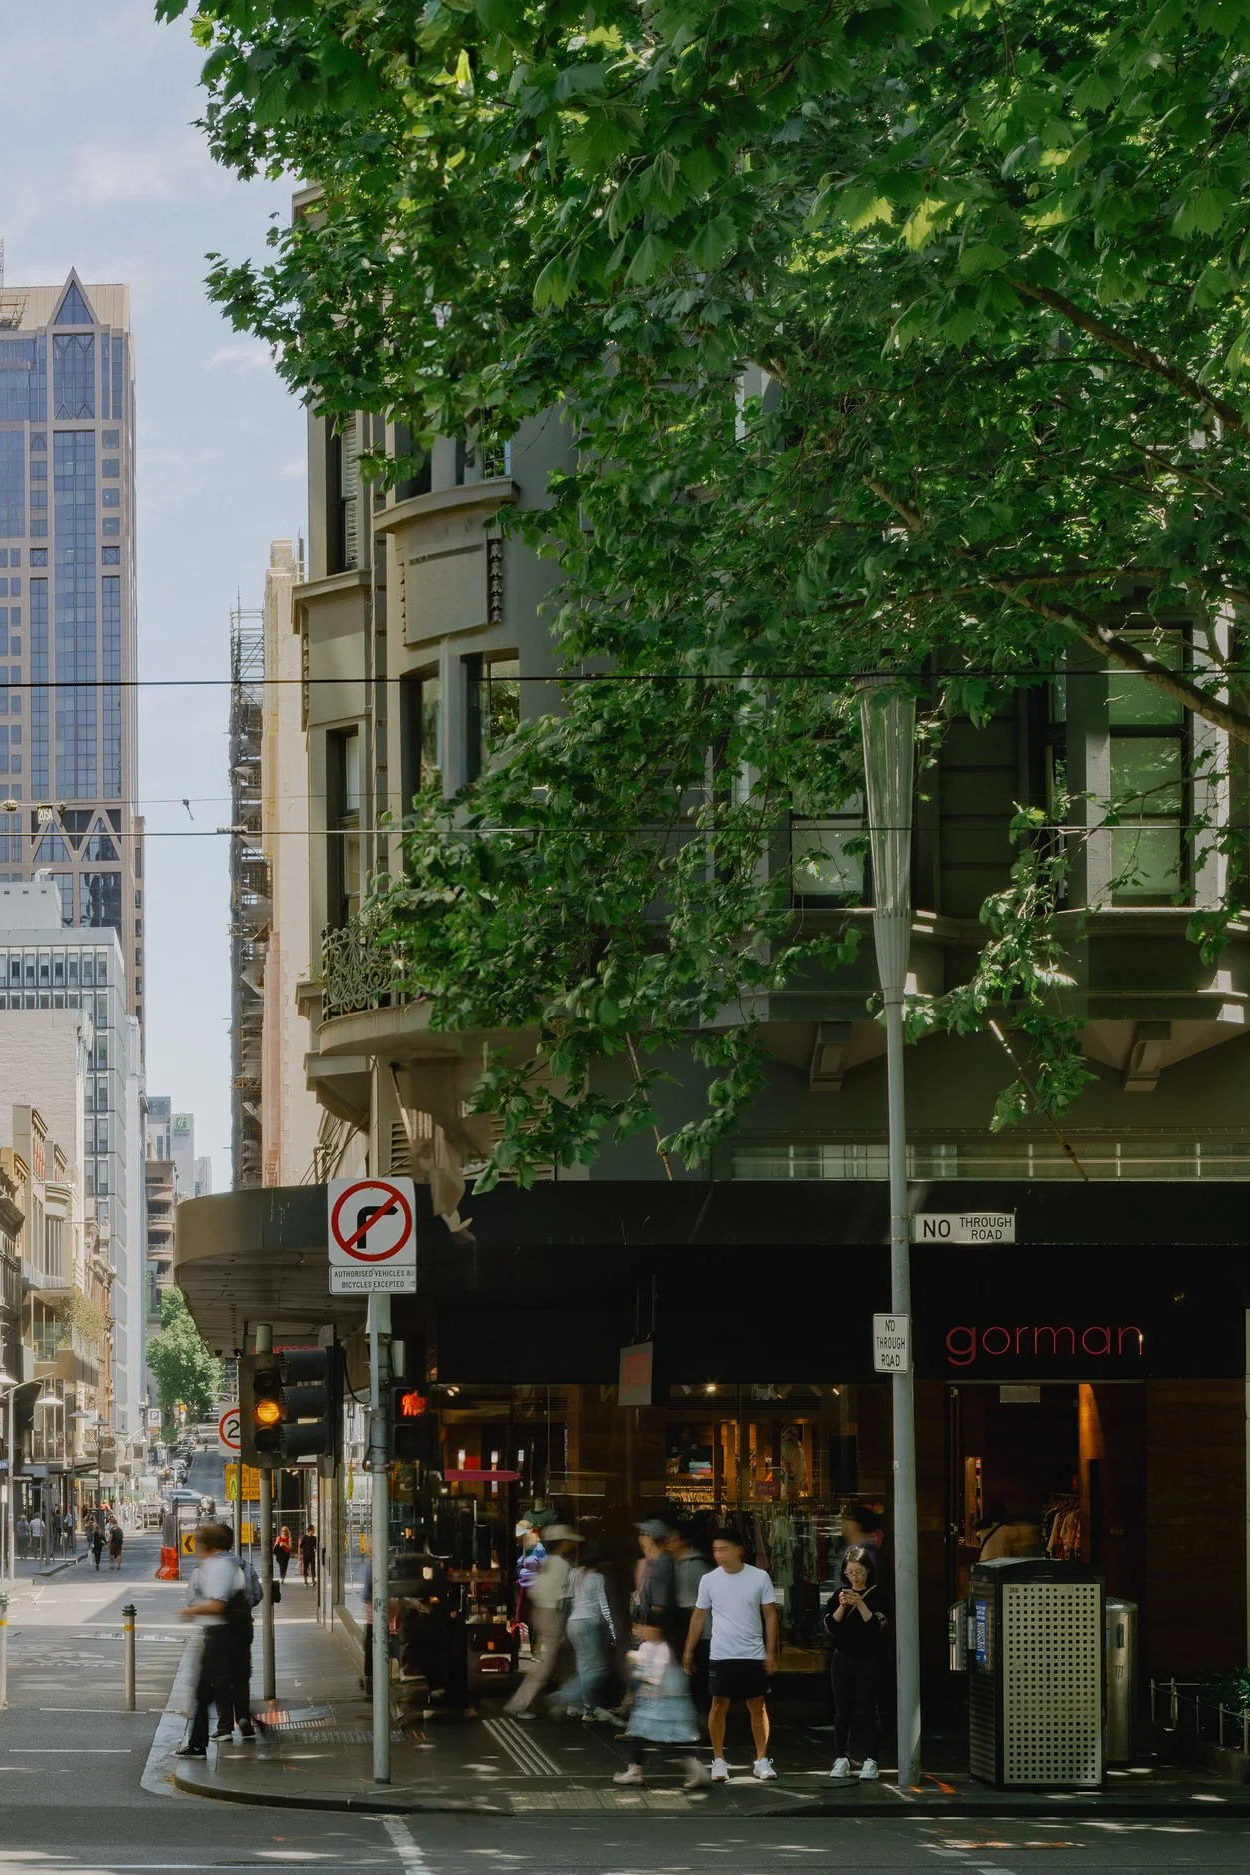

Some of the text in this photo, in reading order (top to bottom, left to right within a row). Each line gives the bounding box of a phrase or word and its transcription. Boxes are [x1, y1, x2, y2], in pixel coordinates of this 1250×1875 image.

[923, 1219, 951, 1238] NO
[959, 1217, 1012, 1227] THROUGH
[971, 1229, 1003, 1240] ROAD
[335, 1270, 373, 1278] AUTHORISED
[375, 1269, 405, 1277] VEHICLES
[341, 1280, 405, 1289] BICYCLES EXCEPTED
[885, 1319, 896, 1332] NO
[876, 1336, 906, 1350] THROUGH
[945, 1326, 1143, 1366] gorman
[881, 1353, 901, 1367] ROAD
[227, 1419, 240, 1438] 2
